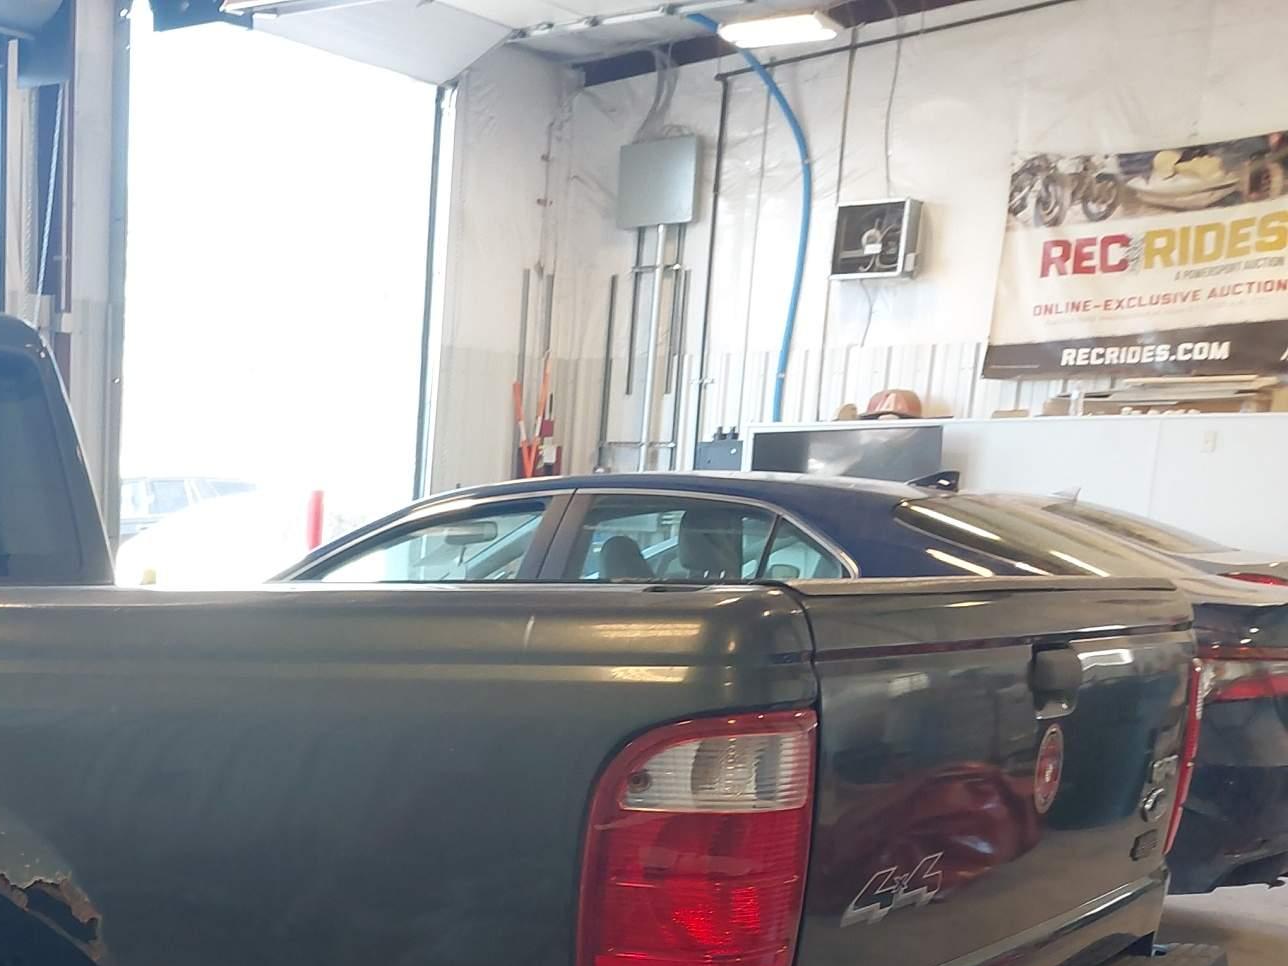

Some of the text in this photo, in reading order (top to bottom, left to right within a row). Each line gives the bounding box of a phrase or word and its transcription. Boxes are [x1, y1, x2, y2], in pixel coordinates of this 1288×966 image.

[1040, 211, 1288, 279] REC RIDES
[1033, 289, 1201, 317] ONLINE-EXCLUSIVE
[1061, 341, 1231, 367] RECRIDES.COM
